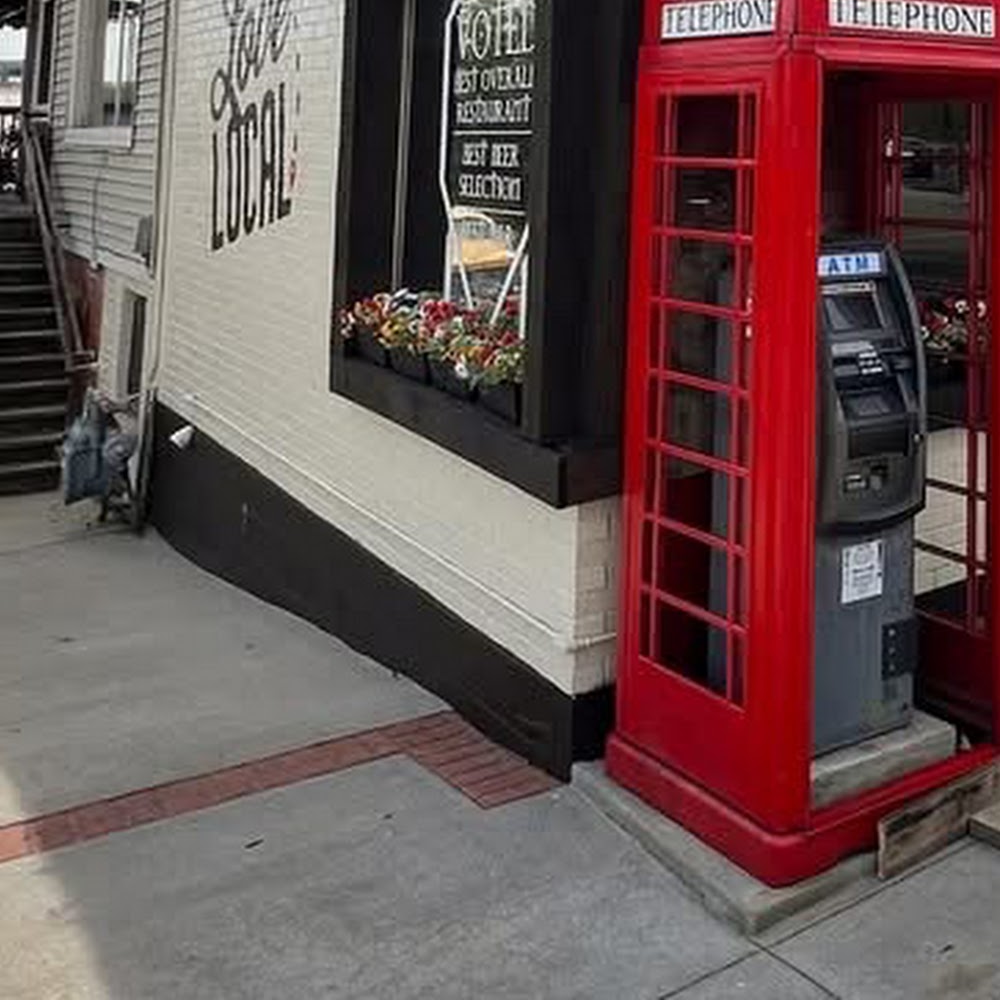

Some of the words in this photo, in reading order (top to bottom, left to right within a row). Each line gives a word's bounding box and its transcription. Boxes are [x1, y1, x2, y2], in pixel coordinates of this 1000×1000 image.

[210, 82, 292, 251] LOCAL
[462, 140, 488, 167] BEST
[491, 143, 519, 168] BEER
[459, 171, 521, 200] SELECTION
[828, 257, 869, 272] ATM
